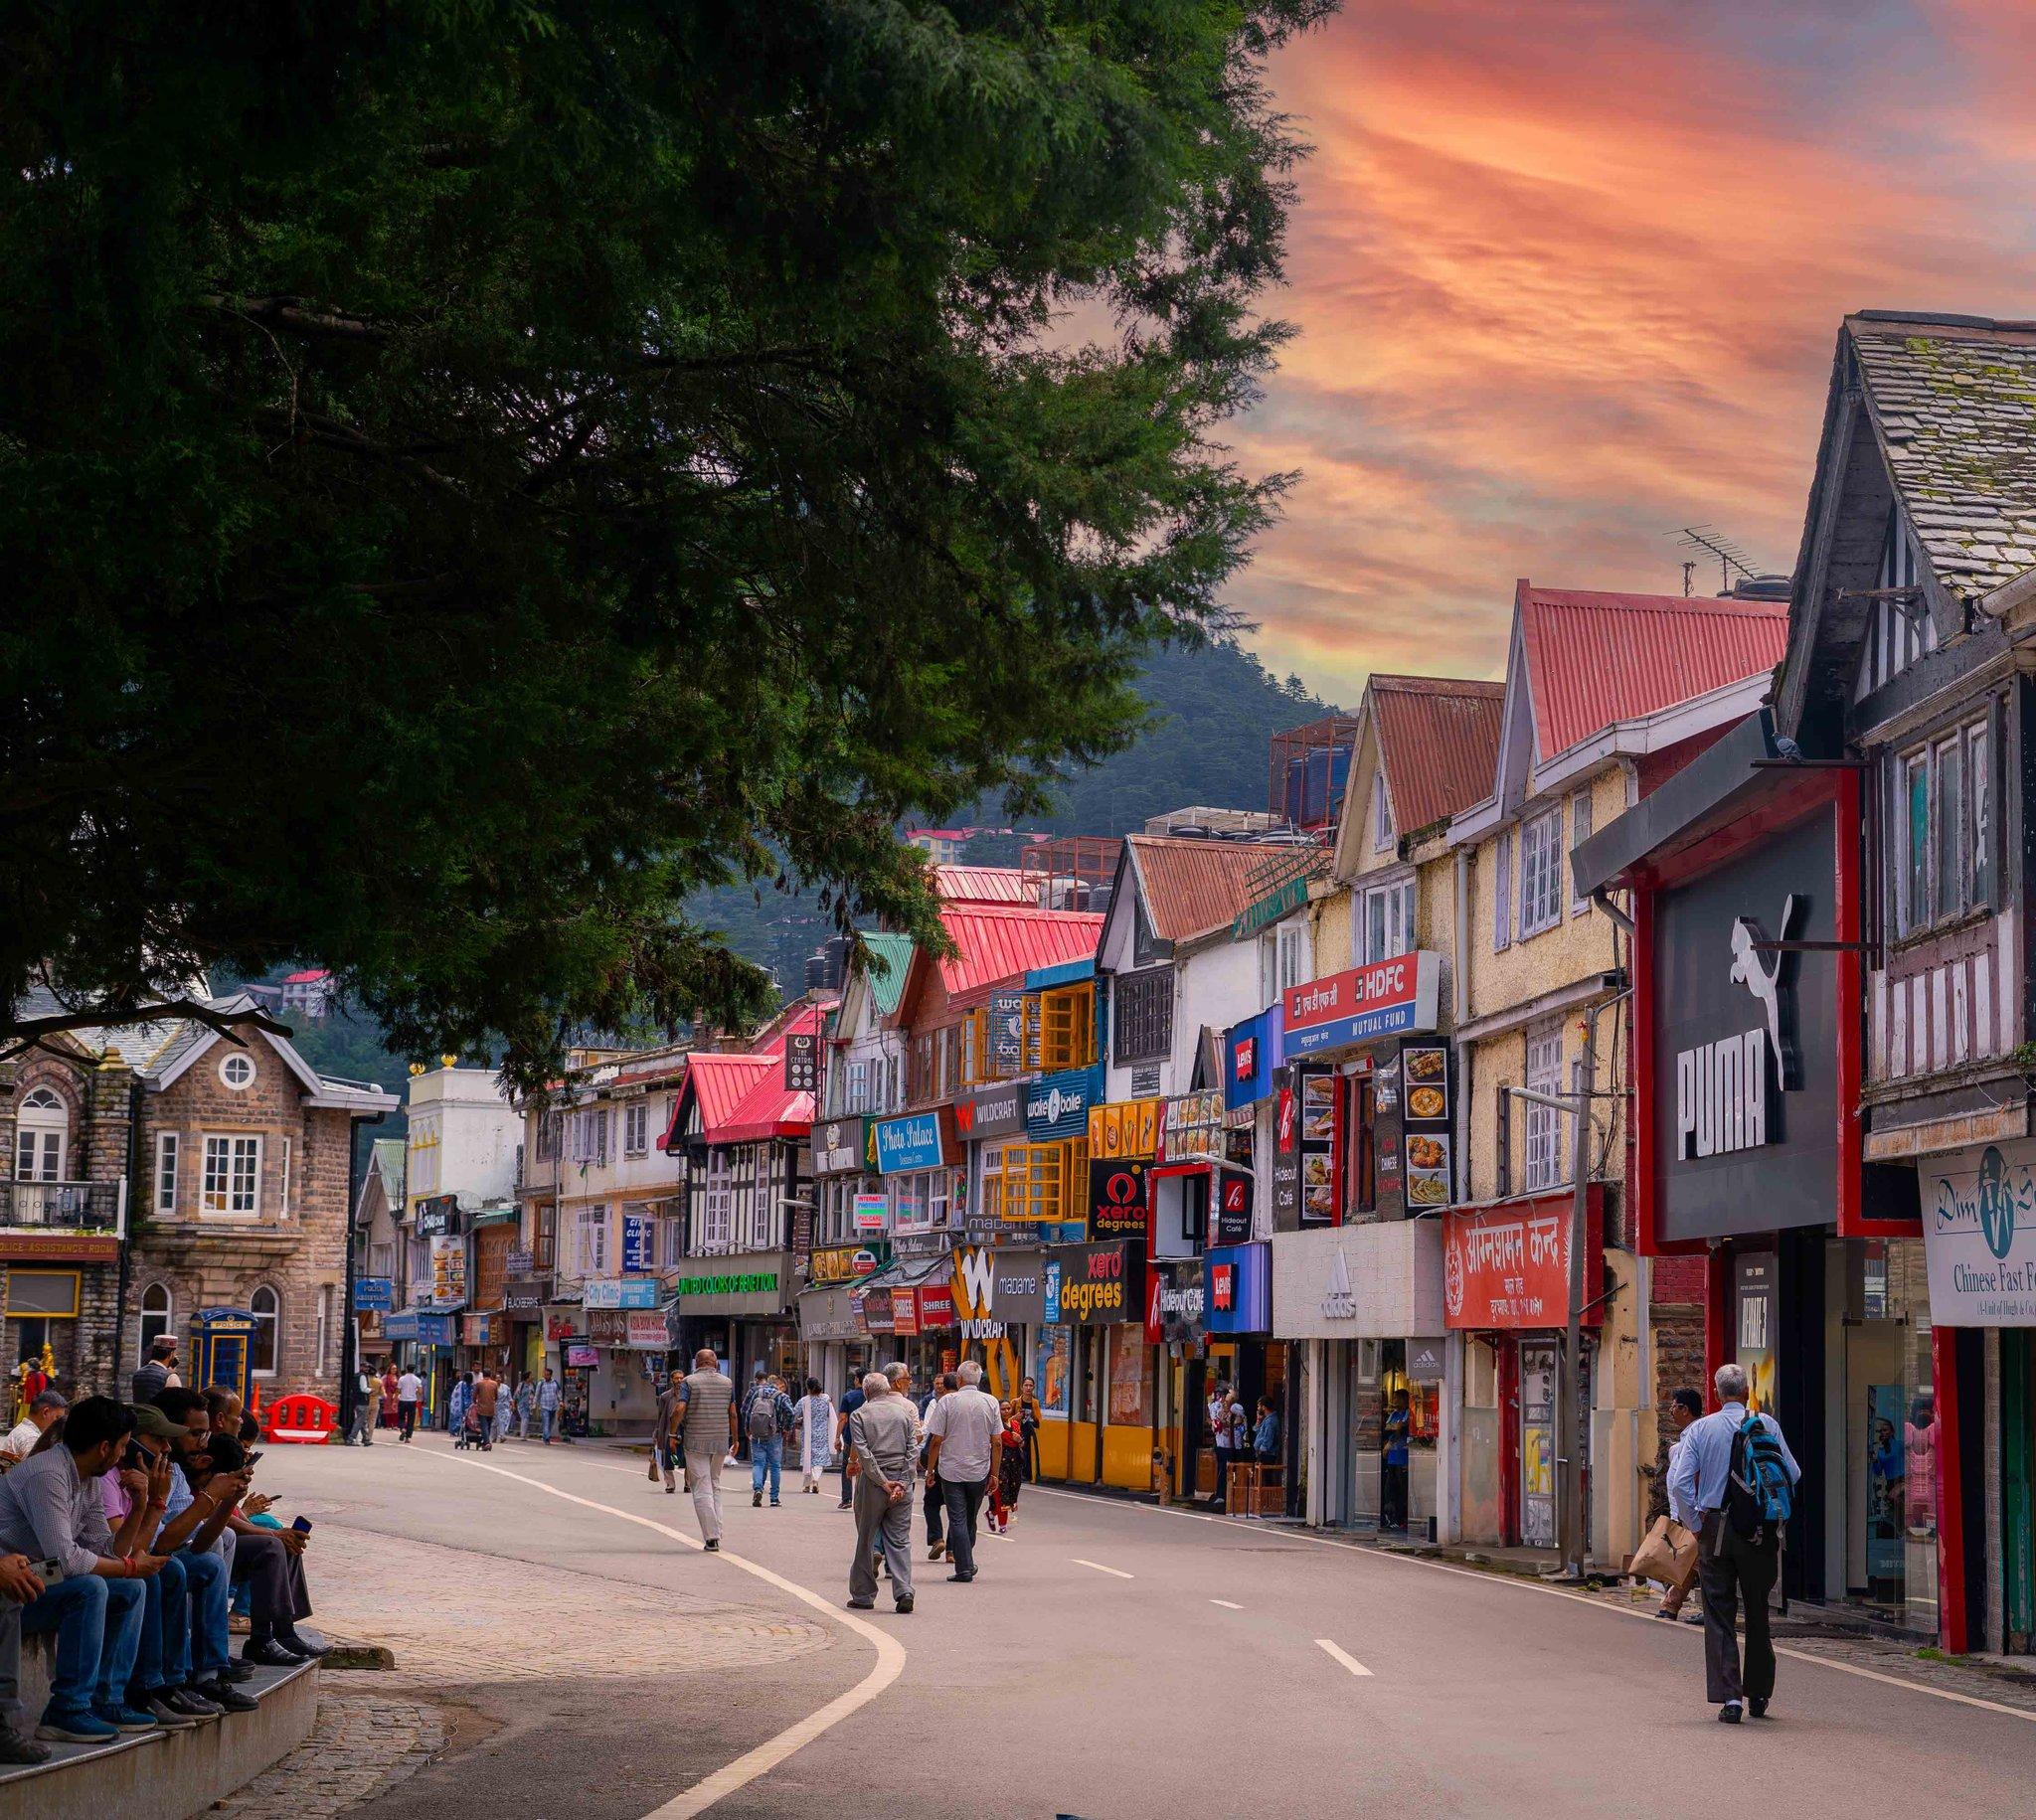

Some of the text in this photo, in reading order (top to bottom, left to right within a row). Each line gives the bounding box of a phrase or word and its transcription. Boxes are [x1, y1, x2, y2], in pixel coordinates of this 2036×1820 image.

[1365, 963, 1405, 1000] HDFC
[1352, 1010, 1406, 1037] MUTUAL FUND
[1028, 1091, 1082, 1118] wake bake
[1677, 1027, 1766, 1161] PUMA
[976, 1097, 1017, 1124] WILDCRAFT
[882, 1119, 934, 1152] Photo Palace
[1274, 1164, 1296, 1182] Hideout
[1278, 1190, 1293, 1206] Café
[1937, 1166, 2036, 1230] Dim S
[1097, 1205, 1145, 1220] xero
[1097, 1218, 1145, 1232] degrees
[1221, 1216, 1248, 1225] Hideout
[29, 1242, 84, 1253] ASSISTANCE
[88, 1243, 113, 1253] ROOM
[1088, 1250, 1122, 1279] xero
[1953, 1262, 1996, 1293] Chinese
[1997, 1262, 2023, 1292] Fast
[590, 1282, 619, 1304] City Clinic
[678, 1277, 702, 1295] UNITED
[703, 1275, 729, 1293] COLORS
[923, 1300, 951, 1311] SHREE
[1061, 1277, 1122, 1321] degrees
[1160, 1287, 1187, 1312] Hideout
